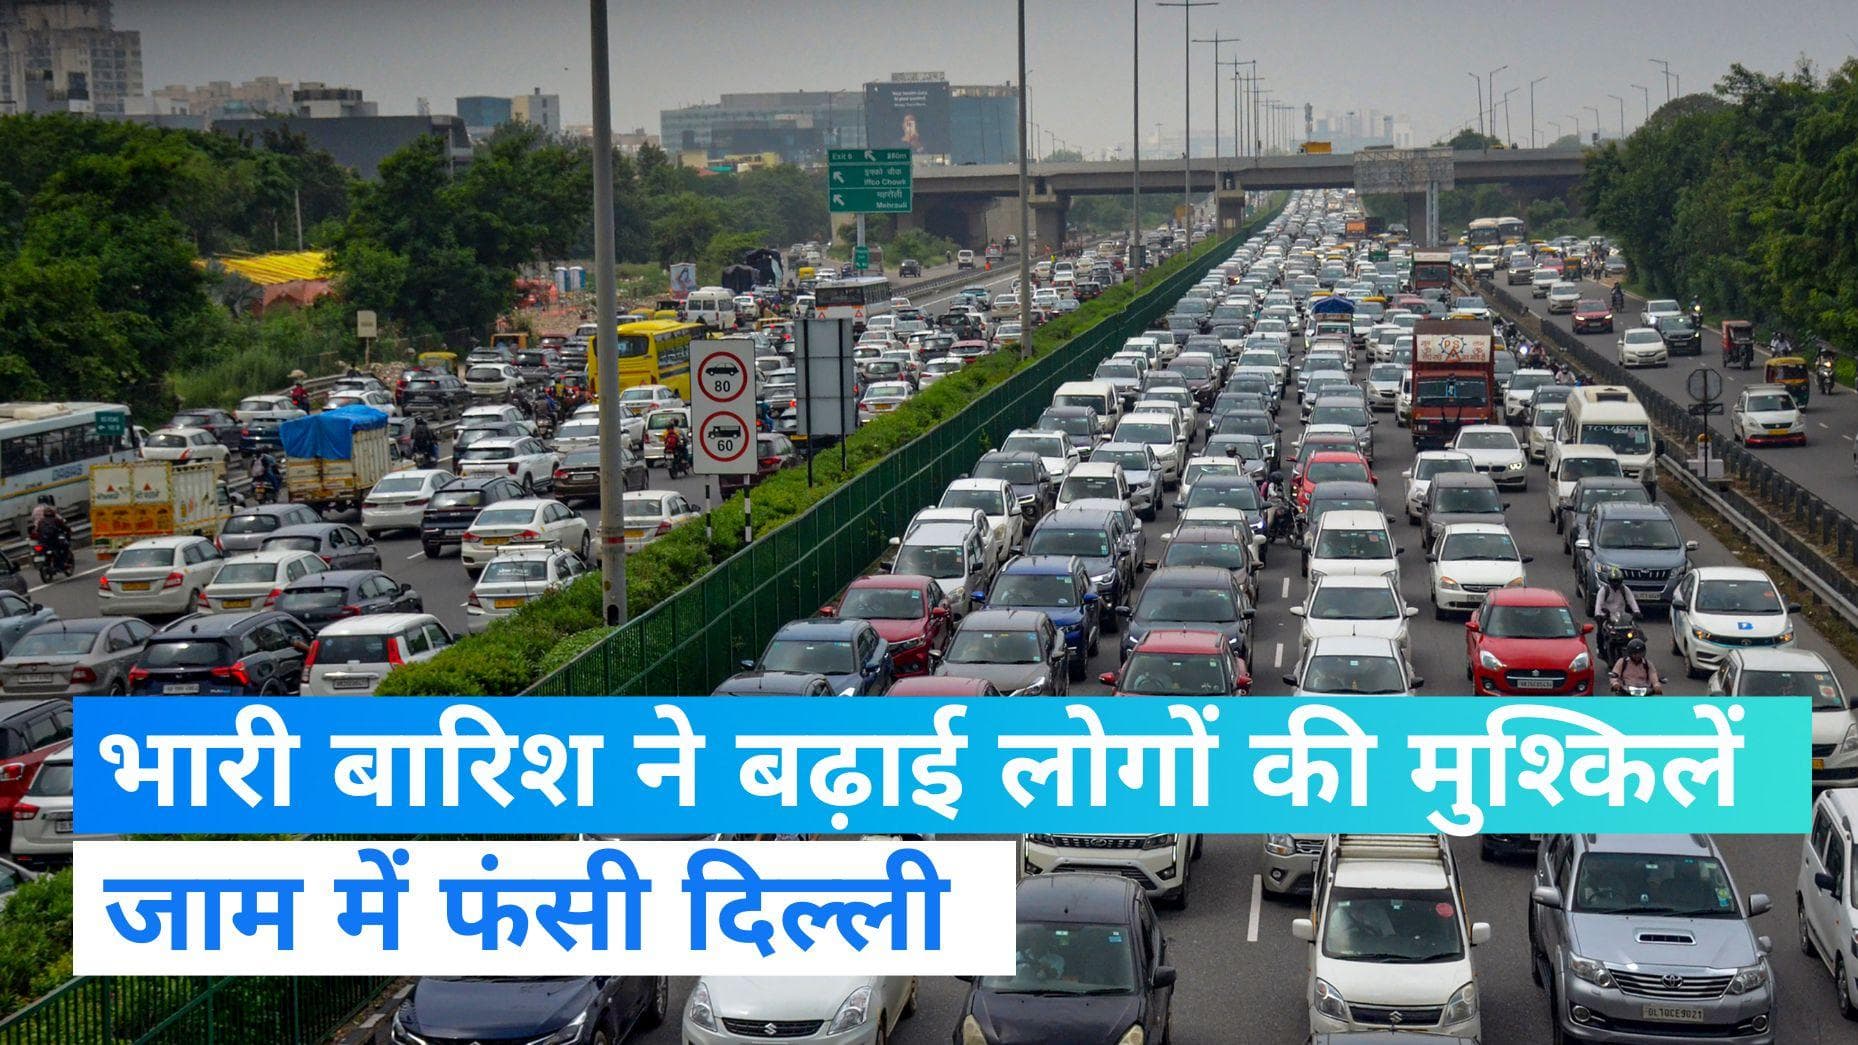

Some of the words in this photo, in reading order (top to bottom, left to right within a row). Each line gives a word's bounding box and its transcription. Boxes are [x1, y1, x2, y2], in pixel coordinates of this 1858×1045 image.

[832, 152, 847, 160] Exit
[714, 380, 731, 392] 80
[717, 439, 733, 452] 60
